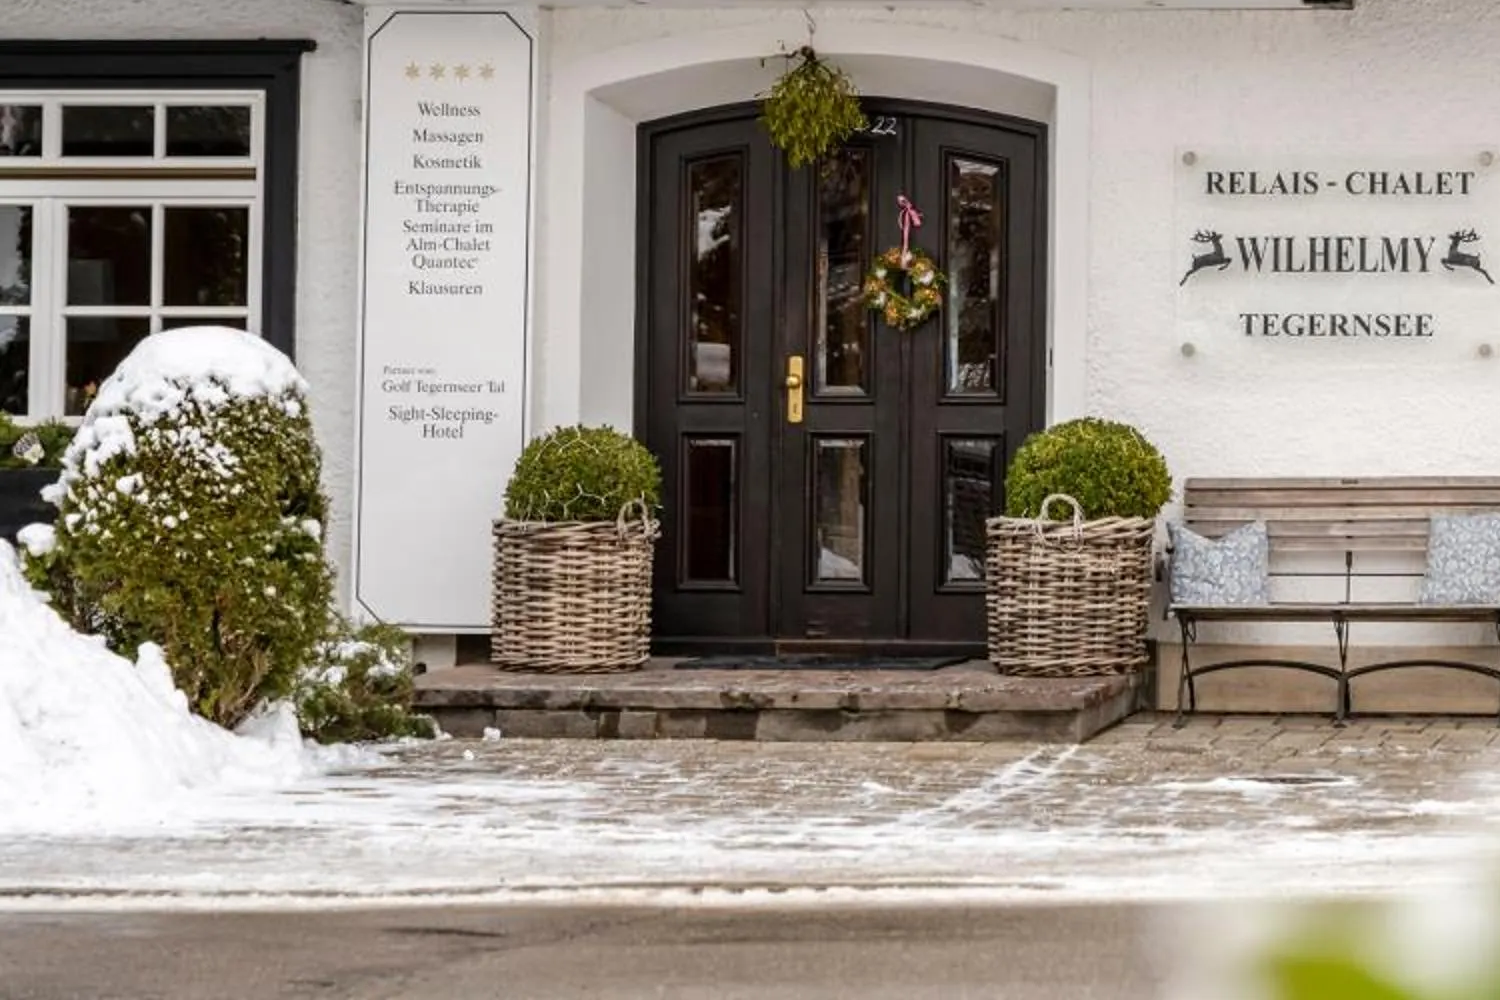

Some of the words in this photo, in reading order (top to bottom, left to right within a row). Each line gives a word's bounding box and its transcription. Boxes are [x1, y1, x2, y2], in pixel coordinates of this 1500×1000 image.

[417, 101, 481, 117] Wellness
[412, 128, 483, 146] Massagen
[412, 154, 482, 169] Kosmetik
[394, 180, 502, 198] Entspannungs-
[415, 199, 480, 217] Therapie
[403, 219, 471, 233] Seminare
[475, 219, 493, 233] im
[405, 237, 491, 251] Alm-Chalet
[1235, 236, 1436, 273] WILHELMY
[408, 280, 483, 295] Klausuren
[1239, 313, 1434, 337] TEGERNSEE
[381, 379, 412, 393] Golf
[416, 380, 483, 395] Tegernseer
[388, 405, 499, 424] Sight-Sleeping-
[422, 424, 464, 439] Hotel
